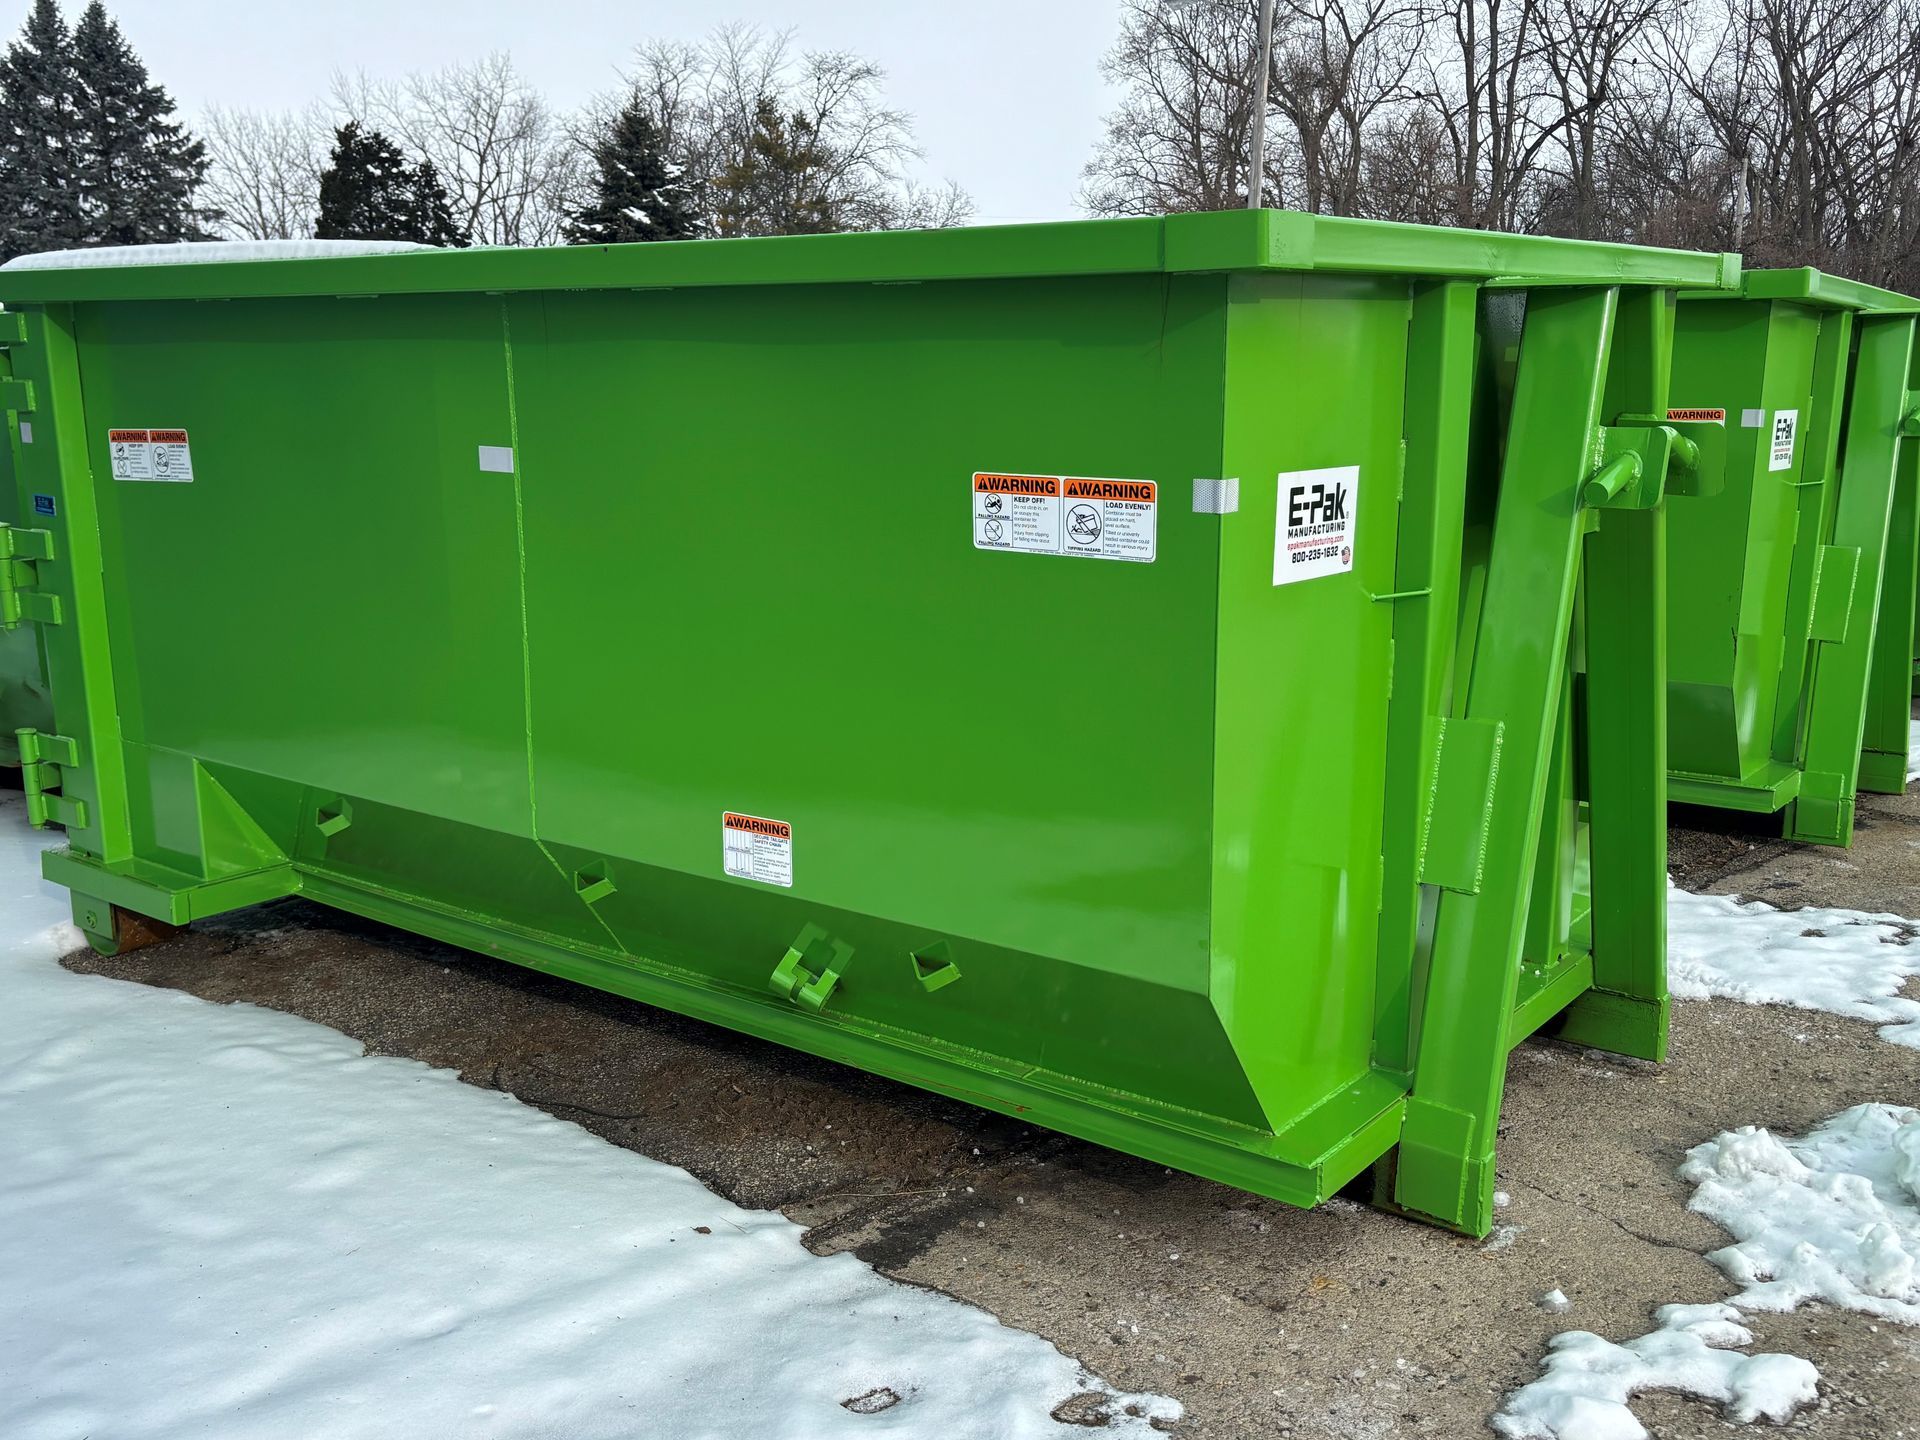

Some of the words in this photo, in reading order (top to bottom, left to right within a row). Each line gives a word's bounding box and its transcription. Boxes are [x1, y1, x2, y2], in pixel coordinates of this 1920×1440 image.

[1673, 411, 1721, 419] WARNING
[116, 432, 146, 441] WARNING
[156, 432, 186, 442] WARNING
[988, 478, 1056, 494] WARNING
[1079, 482, 1151, 499] WARNING
[1288, 482, 1346, 527] E-Pak
[1288, 522, 1345, 539] MANUFACTURING
[1288, 535, 1344, 551] epakmanufacturing.com
[1292, 546, 1338, 563] 800-235-1632
[734, 816, 789, 837] WARNING
